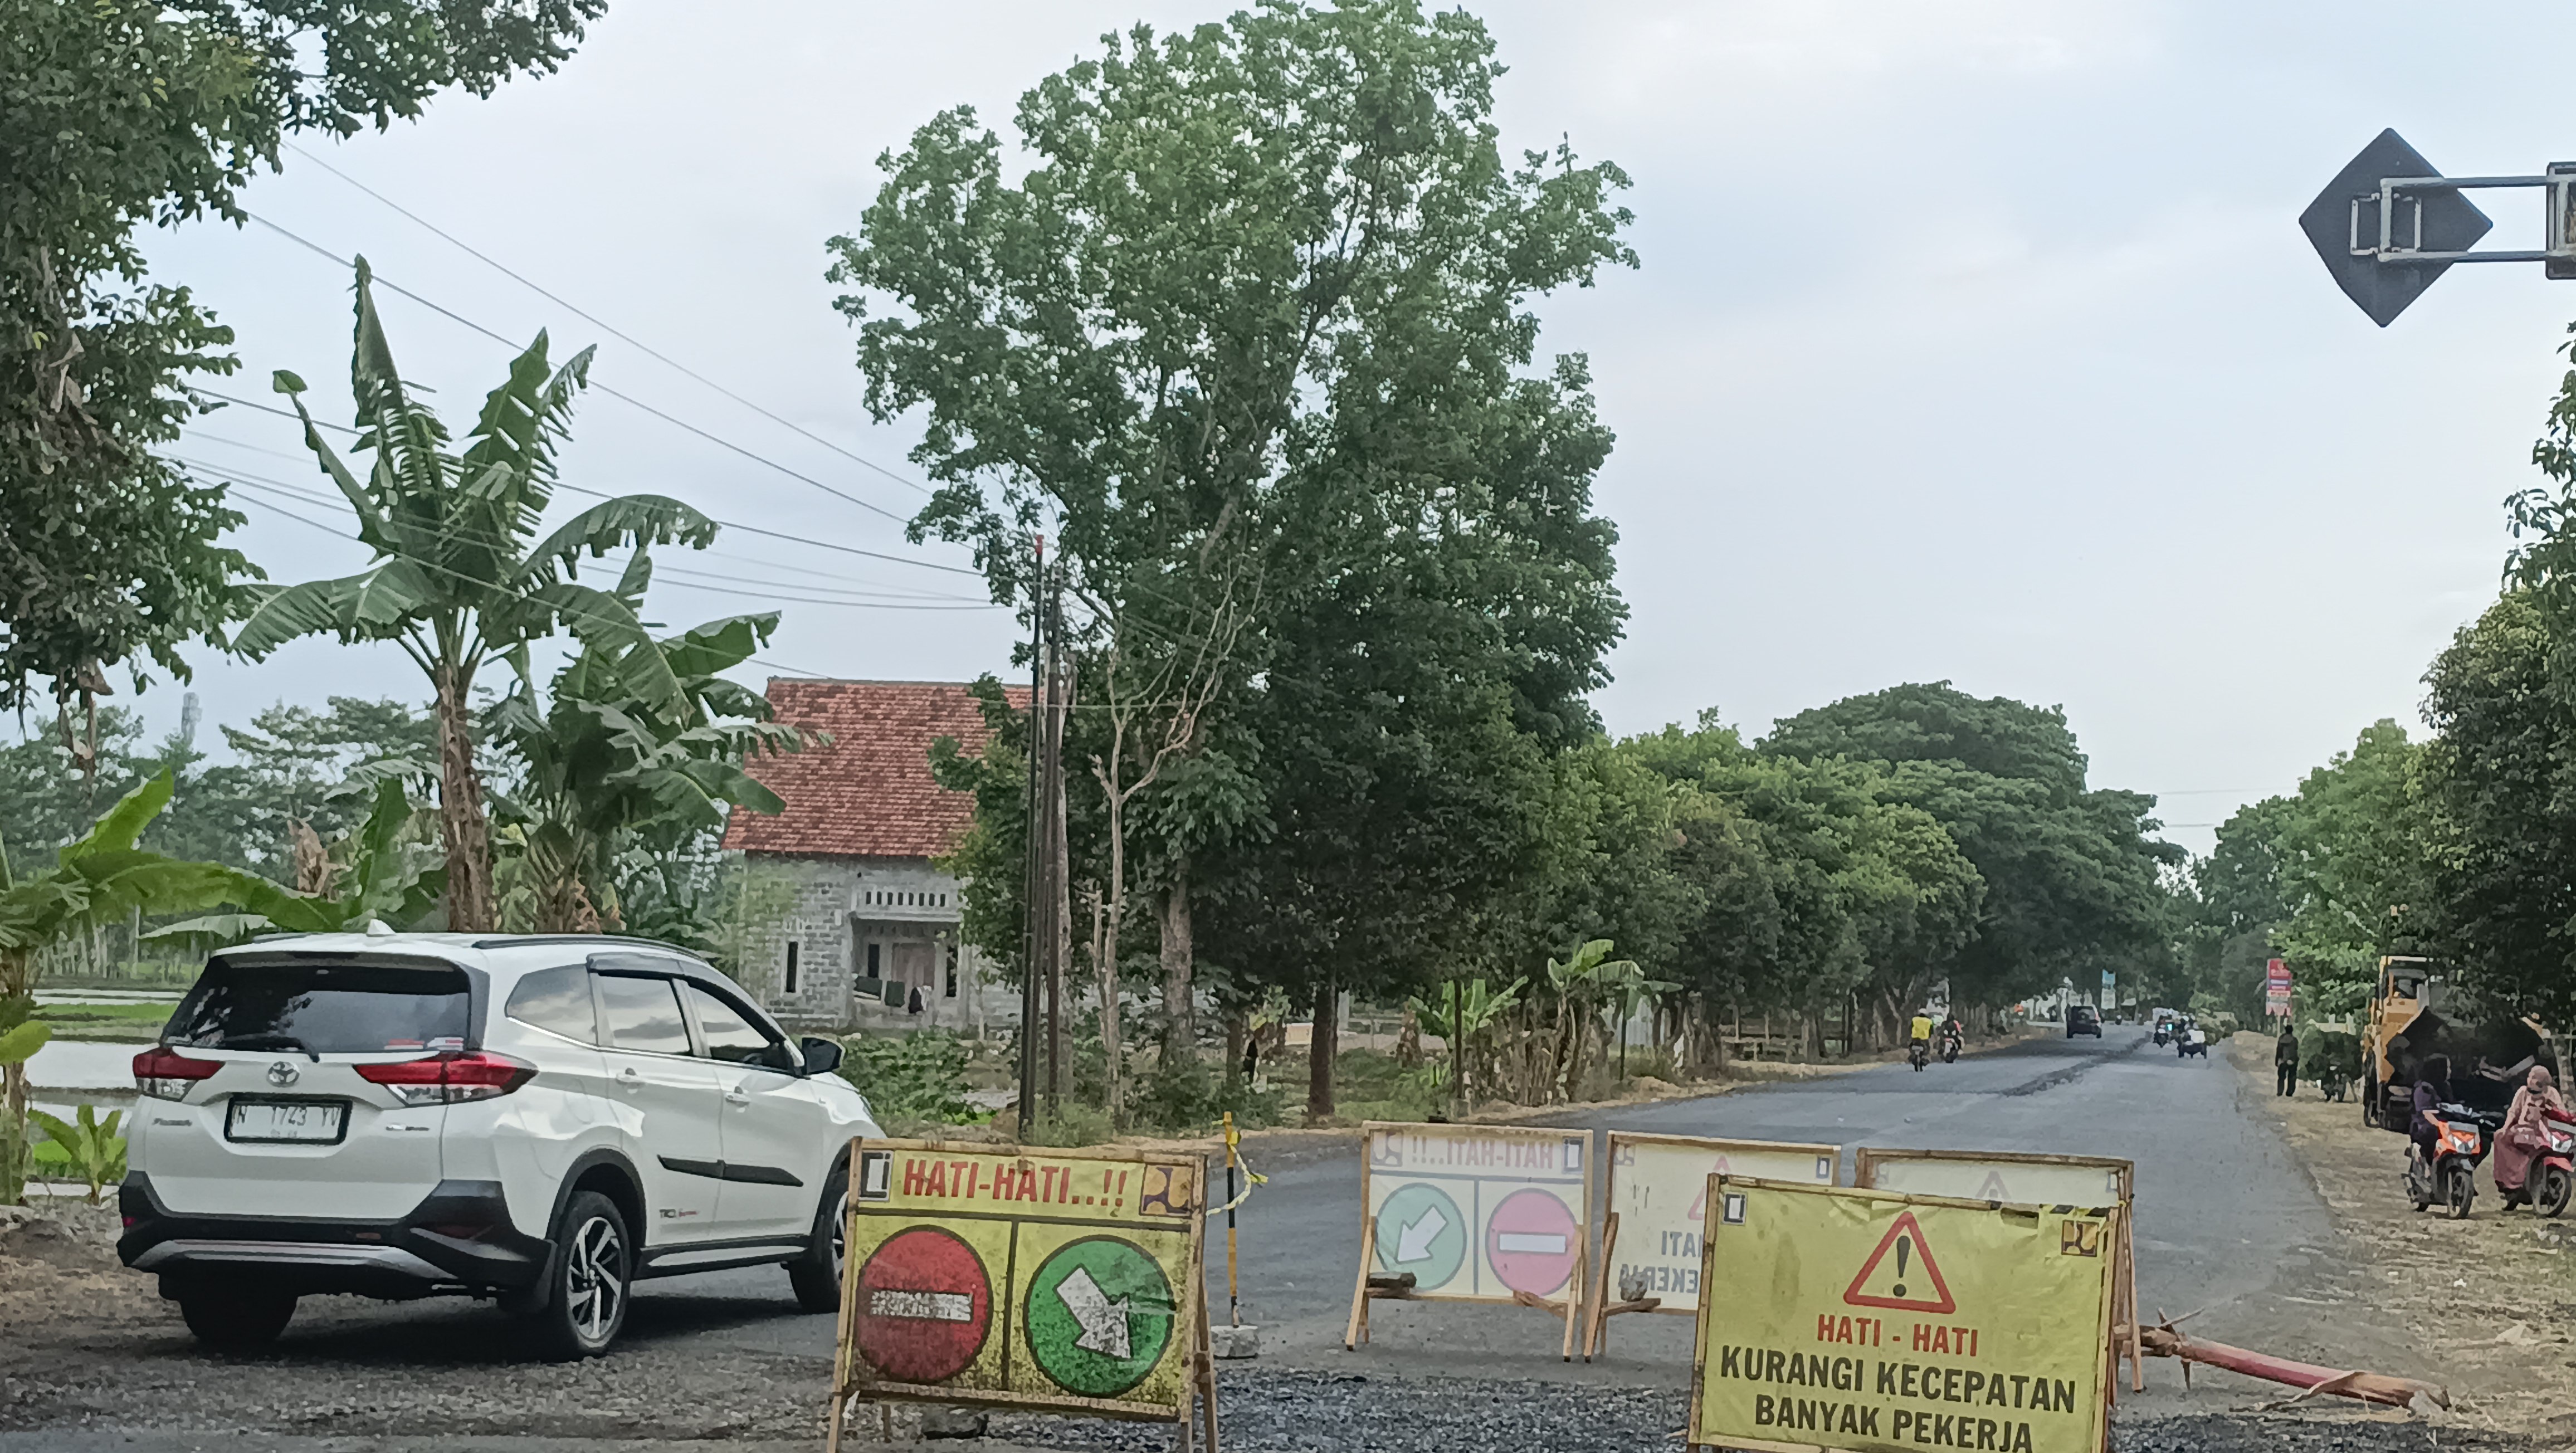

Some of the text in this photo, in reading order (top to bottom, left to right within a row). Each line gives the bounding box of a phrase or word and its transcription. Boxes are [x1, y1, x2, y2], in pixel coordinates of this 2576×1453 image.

[1818, 1314, 1881, 1347] HATI
[1913, 1324, 1978, 1357] HATI
[1721, 1345, 2076, 1413] KURANGI KECEPATAN
[1755, 1394, 2032, 1453] BANYAK PEKERJA
